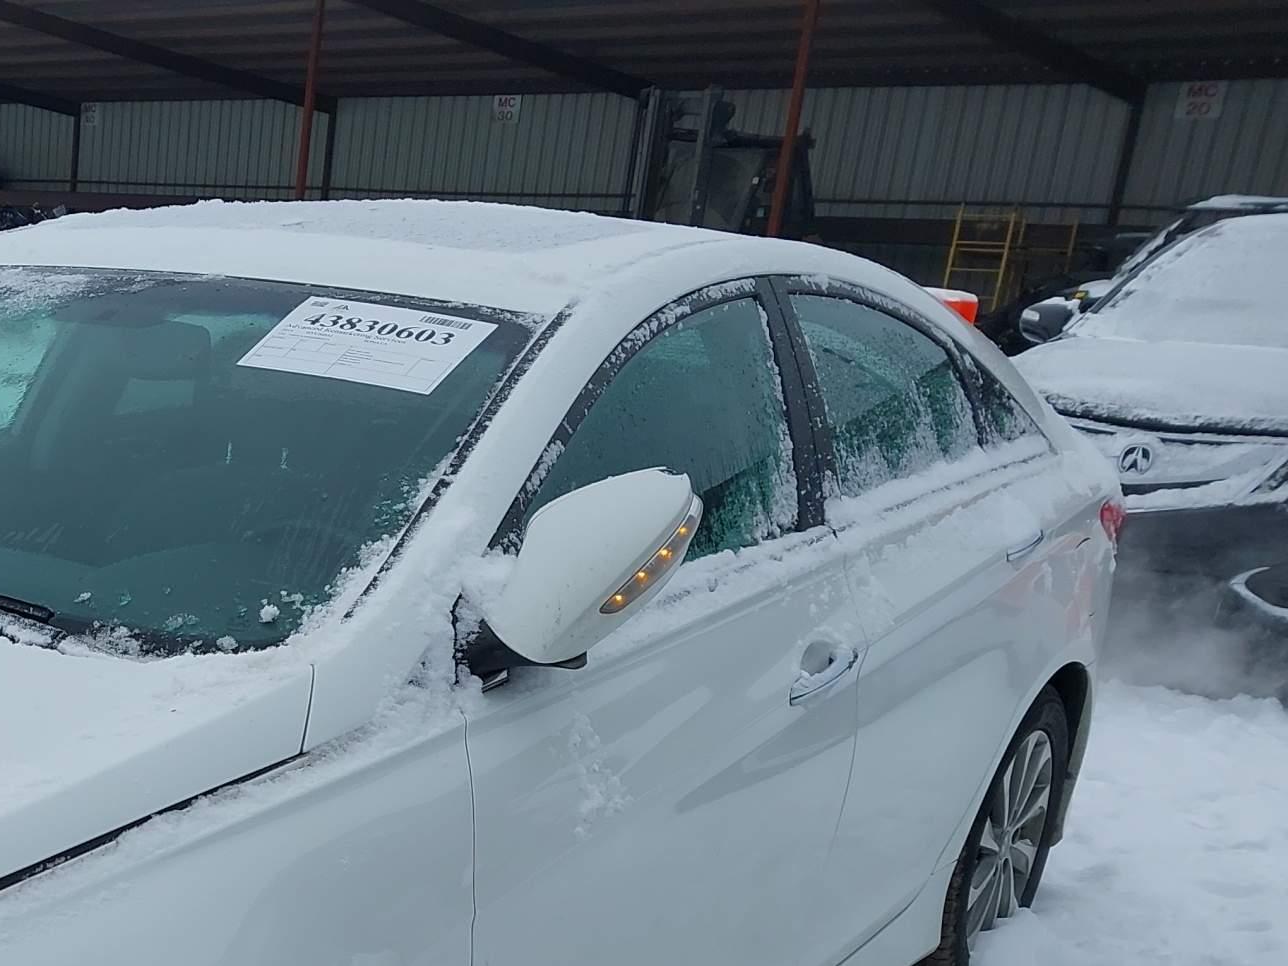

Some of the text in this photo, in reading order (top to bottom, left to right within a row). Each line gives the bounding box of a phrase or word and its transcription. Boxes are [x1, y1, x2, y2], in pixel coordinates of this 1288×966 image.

[497, 97, 517, 109] MC
[1185, 102, 1211, 116] 20
[497, 111, 513, 121] 30
[304, 313, 456, 346] 43830603
